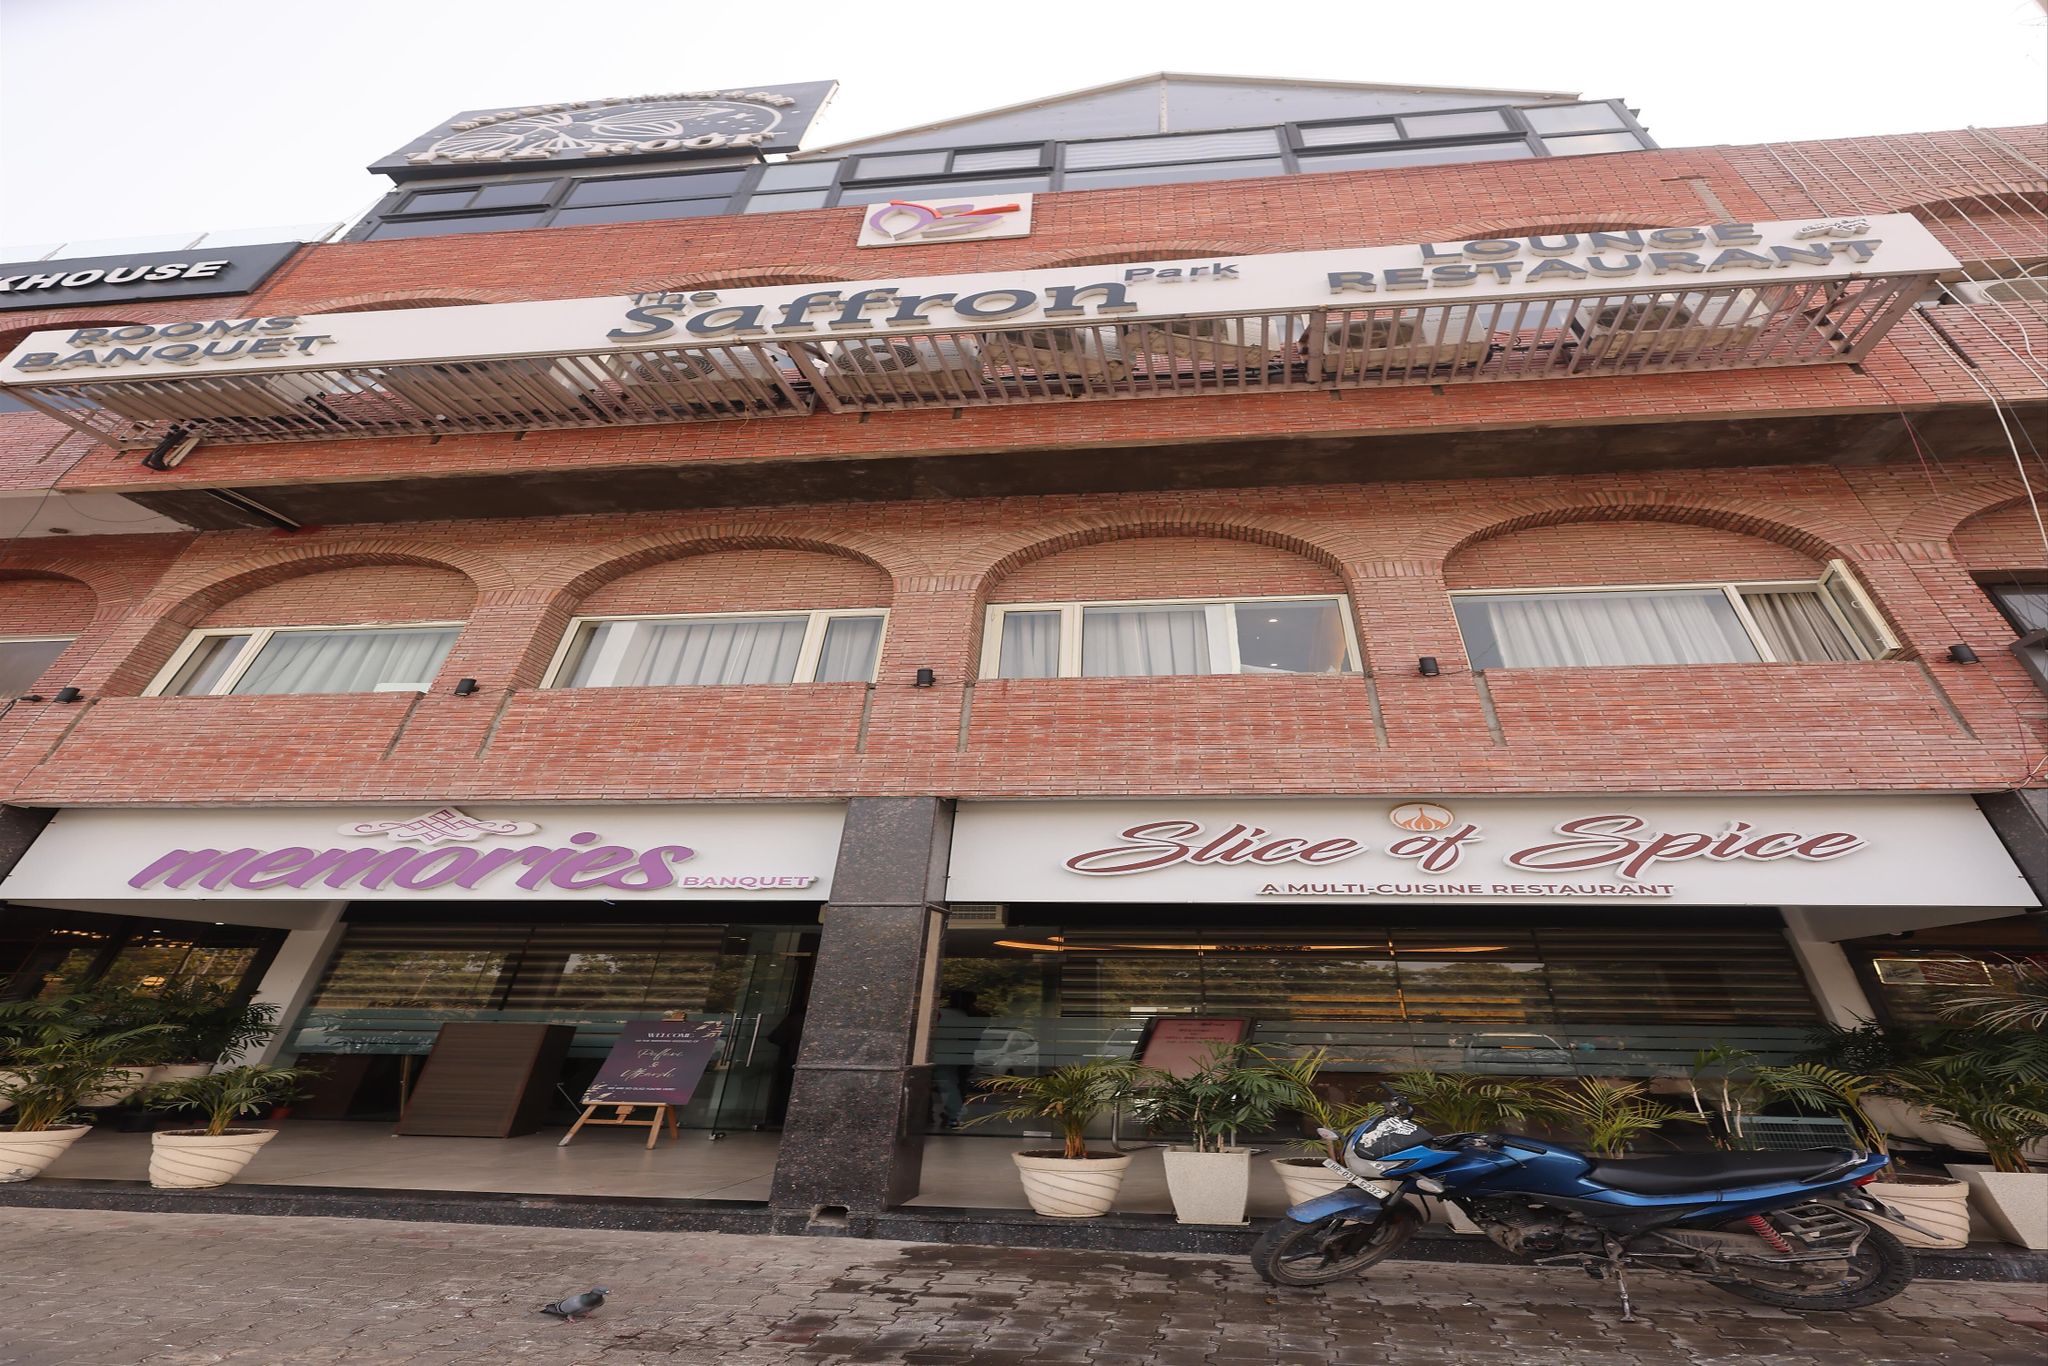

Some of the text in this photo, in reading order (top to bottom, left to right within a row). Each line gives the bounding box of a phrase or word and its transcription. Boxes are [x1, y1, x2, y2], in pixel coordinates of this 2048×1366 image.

[1420, 223, 1763, 264] LOUNGE
[1125, 263, 1240, 284] Park
[1328, 239, 1883, 293] RESTAURANT
[606, 281, 1137, 341] Saffron
[630, 291, 719, 306] The
[66, 316, 302, 347] ROOMS
[13, 334, 333, 372] BANQUET
[128, 831, 812, 891] memories BANQUET
[1066, 815, 1860, 880] Slice of Spice
[1261, 883, 1675, 895] A MULTI-CUISINE RESTAURANT
